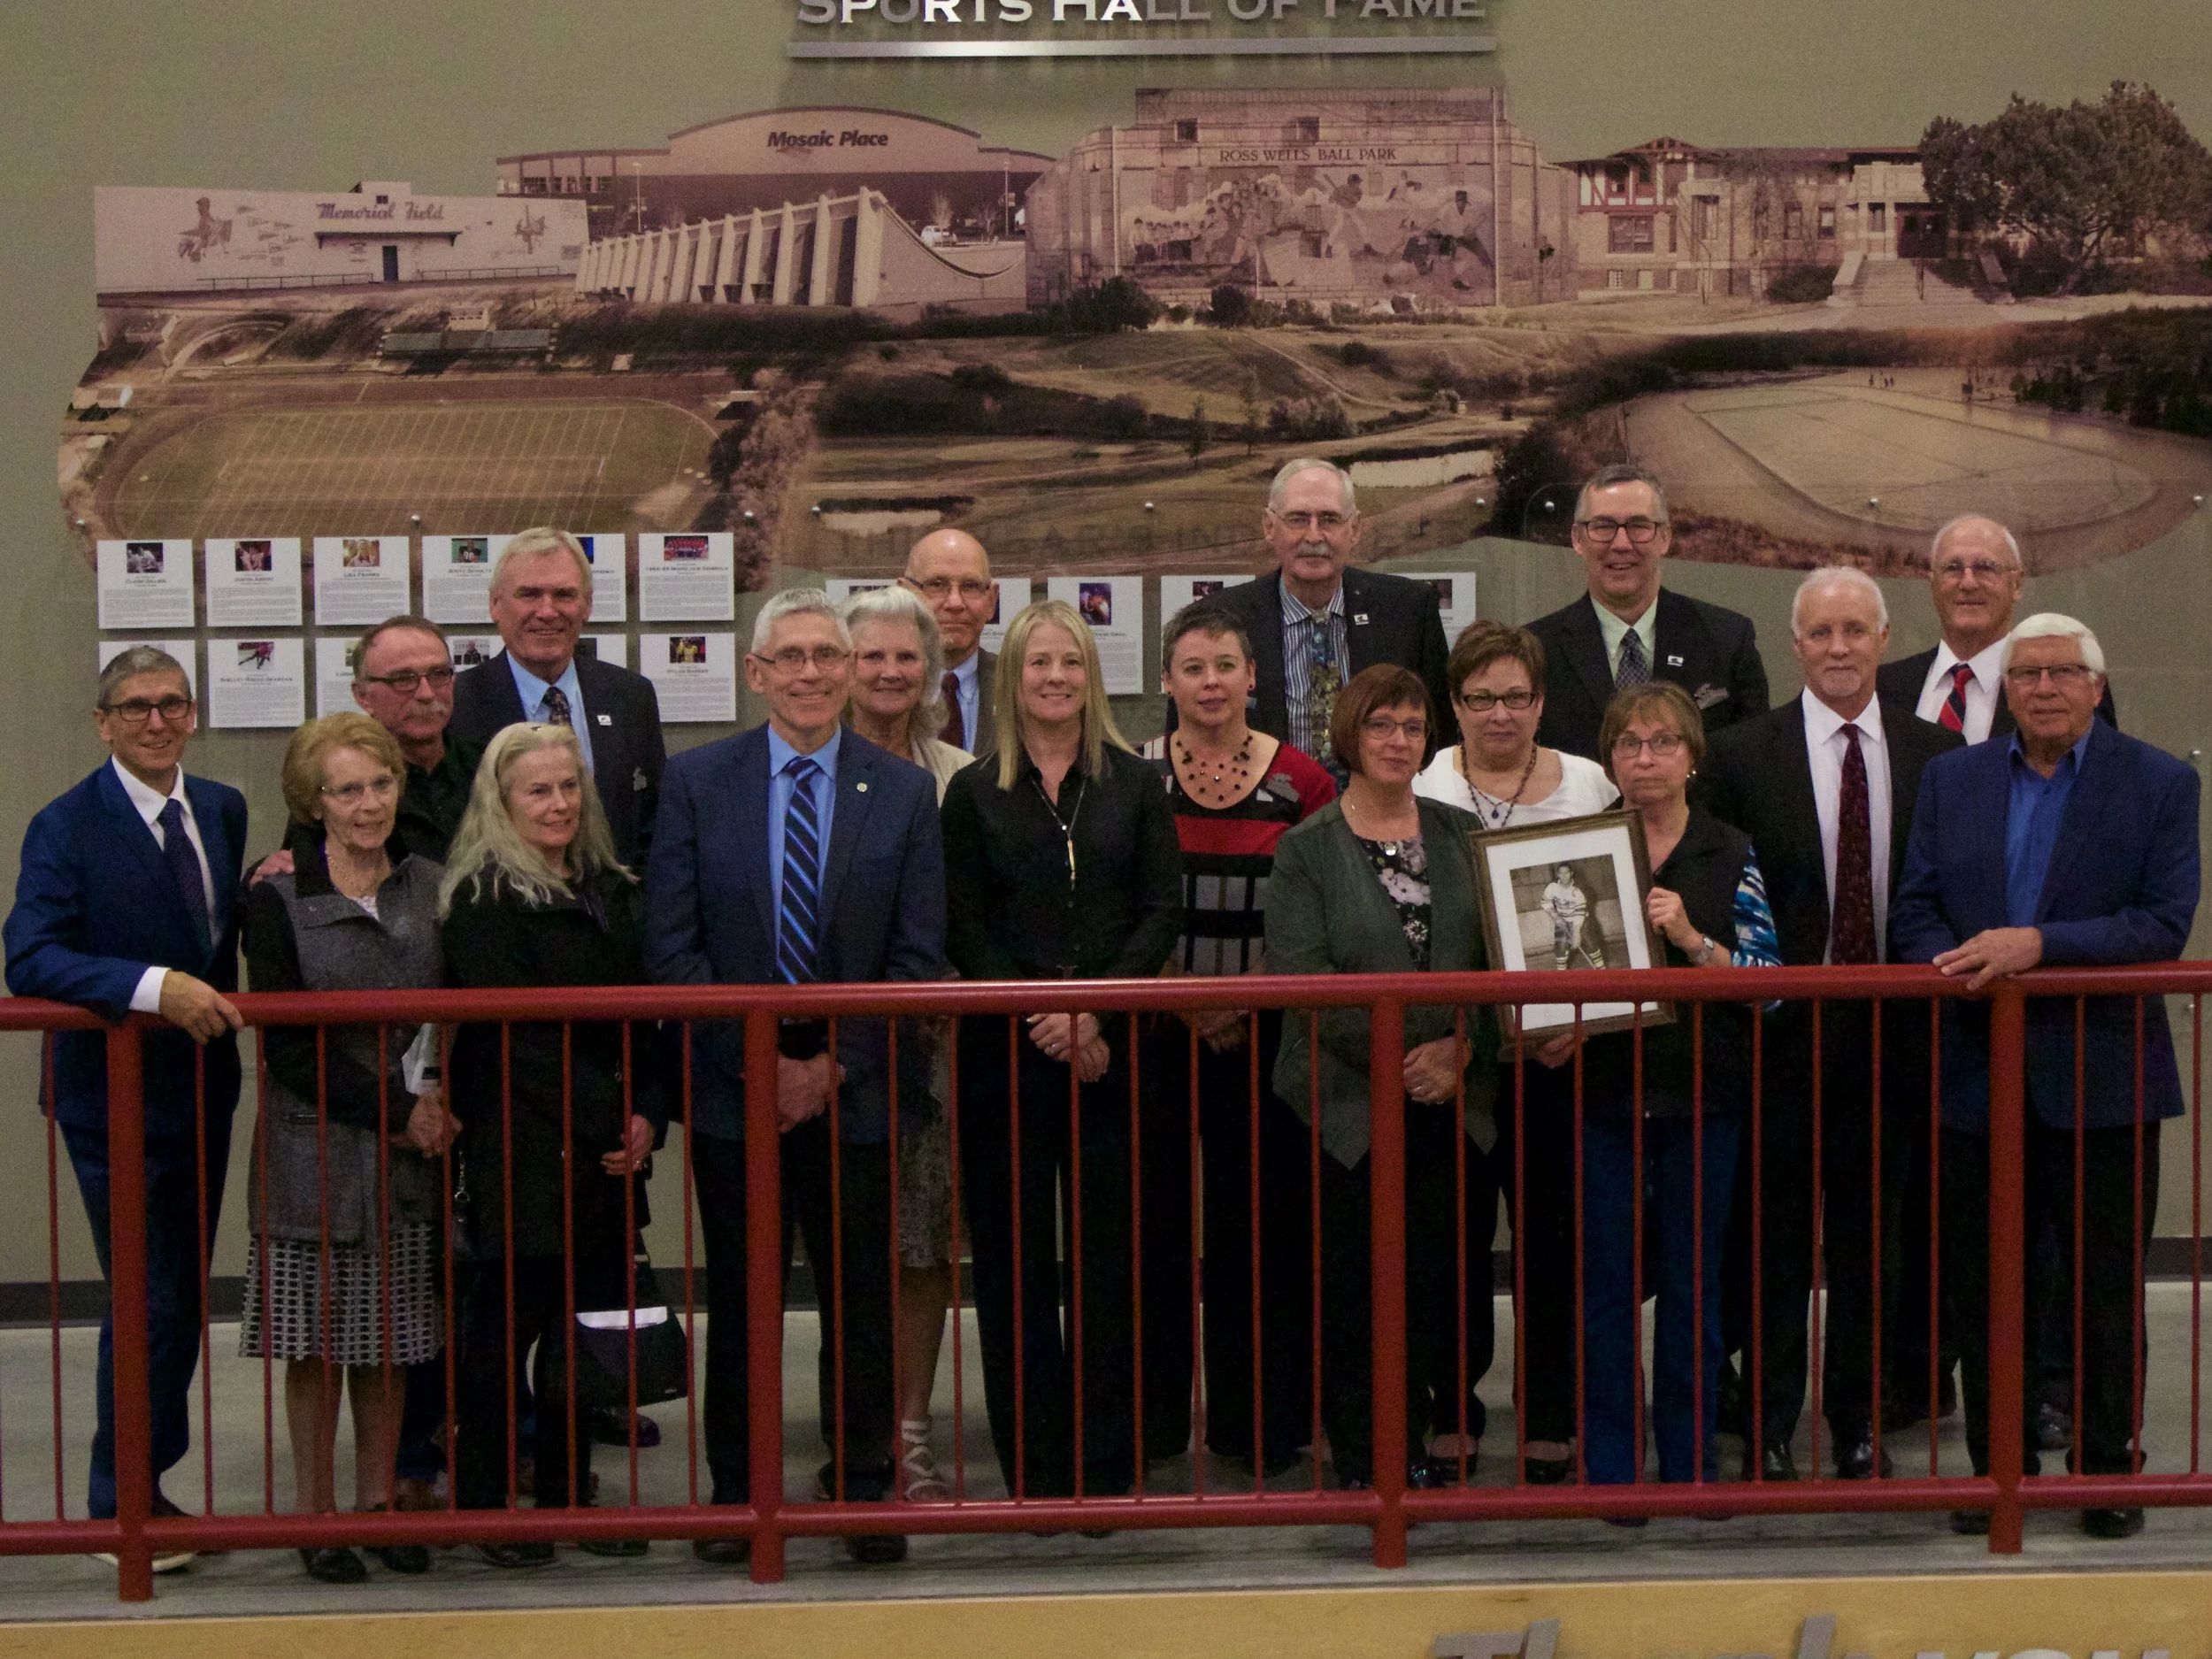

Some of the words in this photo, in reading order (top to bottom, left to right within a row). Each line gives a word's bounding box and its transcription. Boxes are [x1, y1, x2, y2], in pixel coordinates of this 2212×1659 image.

[1052, 0, 1211, 23] HALL
[1227, 0, 1297, 21] OF
[768, 130, 835, 147] Mosaic
[839, 130, 888, 147] Place
[1219, 149, 1259, 162] ROSS
[1317, 148, 1352, 161] BALL
[1359, 147, 1397, 161] PARK
[316, 202, 397, 220] Memorial
[404, 201, 444, 220] Field
